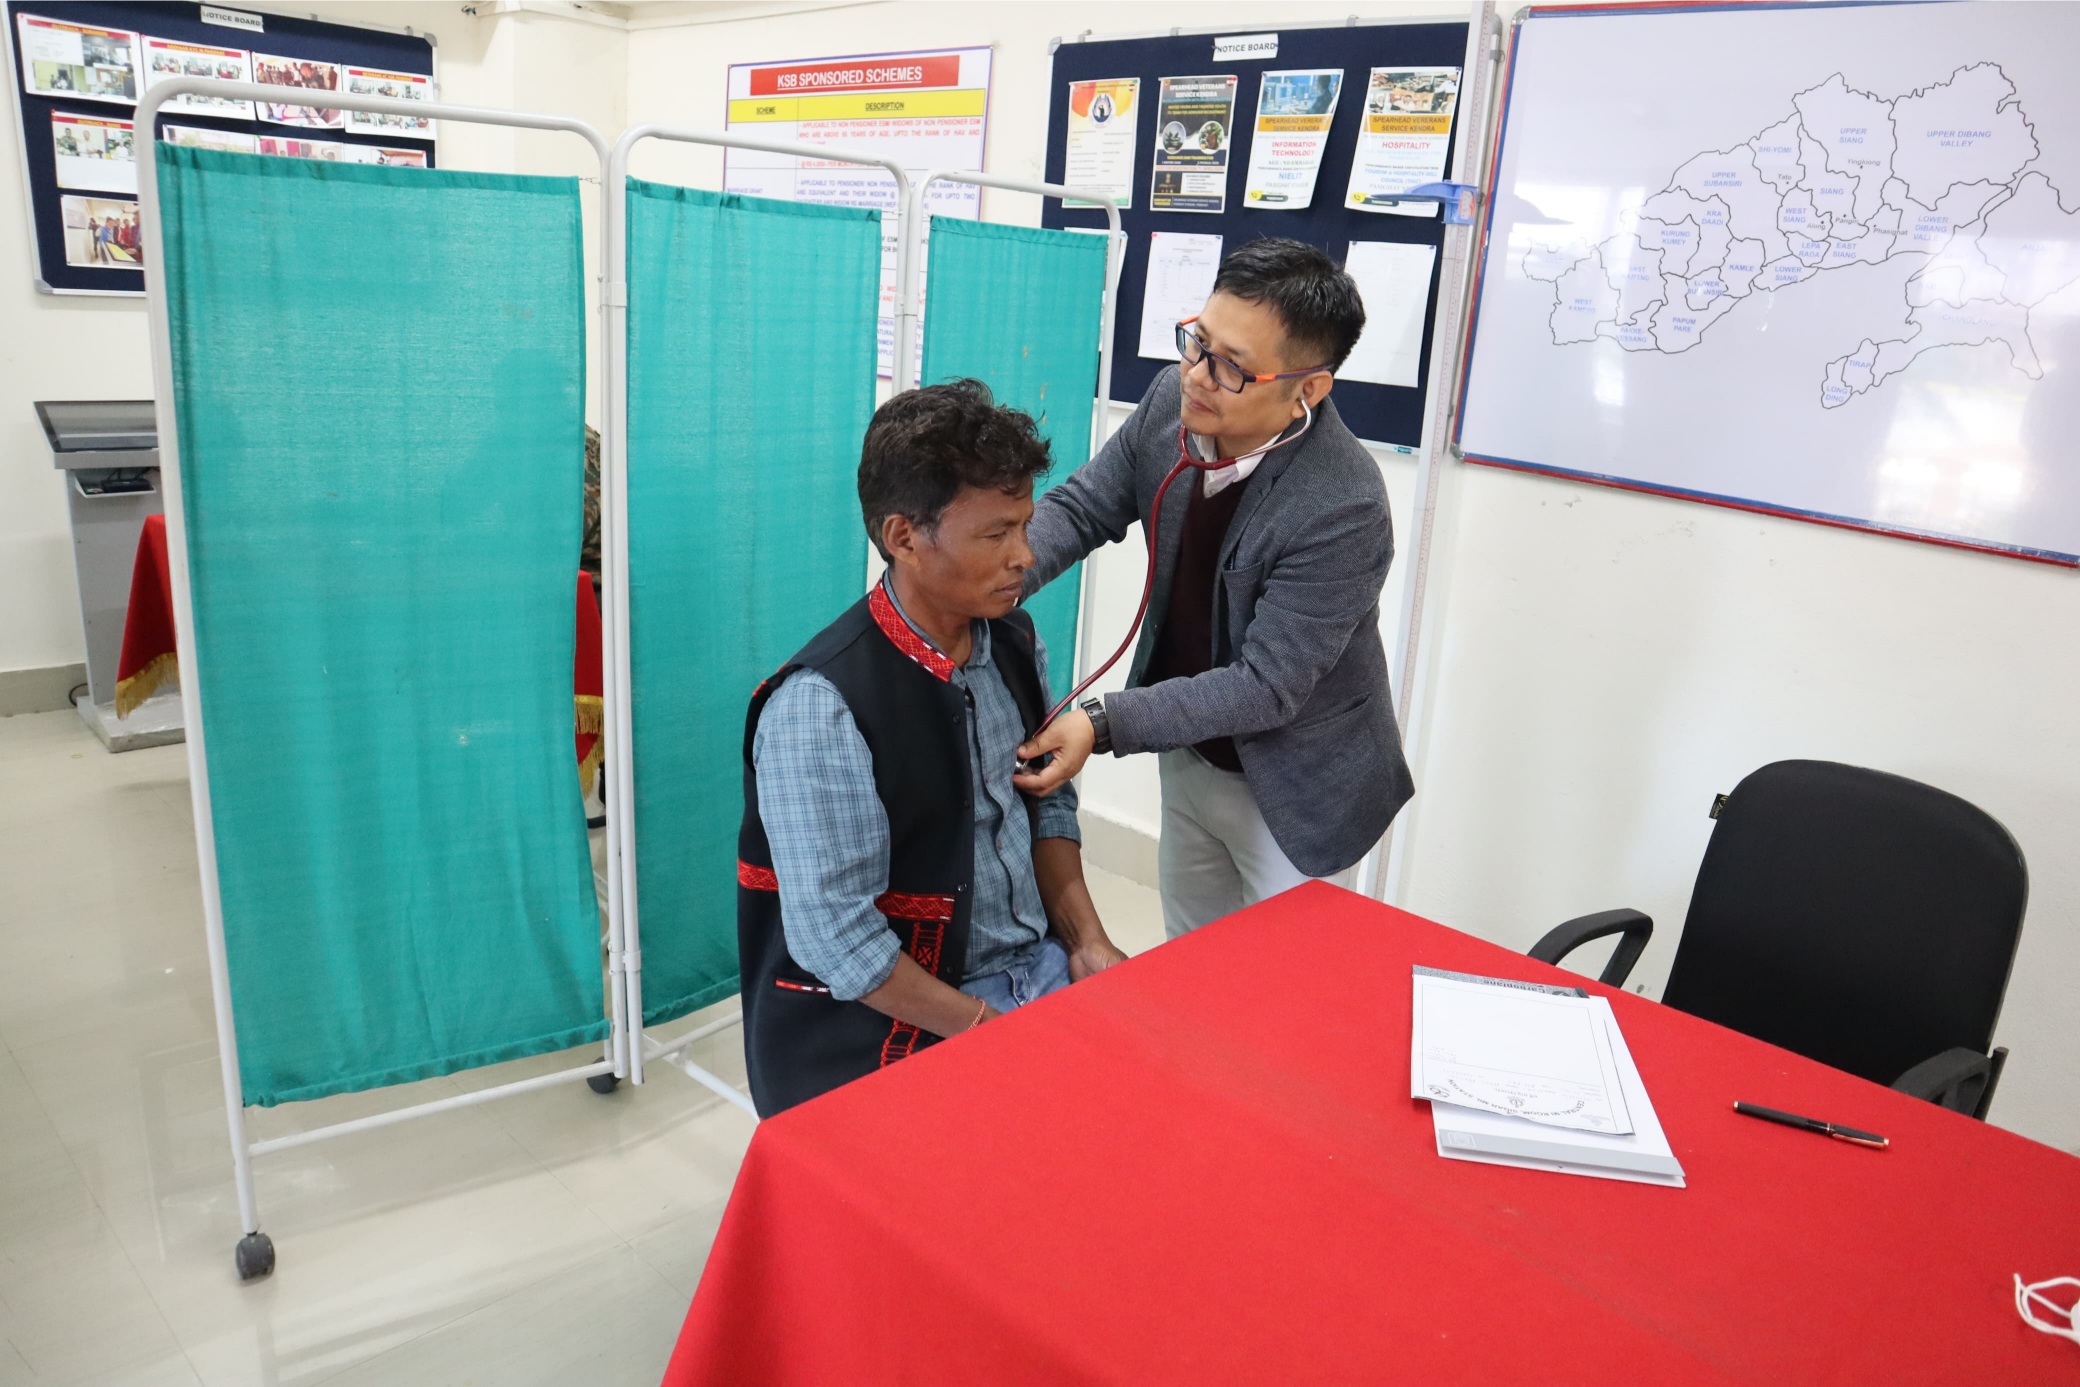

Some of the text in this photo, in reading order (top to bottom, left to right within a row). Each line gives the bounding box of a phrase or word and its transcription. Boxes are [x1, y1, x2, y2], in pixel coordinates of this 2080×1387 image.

[234, 16, 261, 26] BOARD
[1216, 42, 1276, 53] NOTICE BOARD
[777, 65, 923, 88] KSB SPONSORED SCHEMES
[756, 101, 905, 115] SCHEME DESCRIPTION
[1412, 116, 1447, 124] VERERANS
[968, 128, 980, 136] AND
[1840, 127, 1868, 135] UPPER
[1926, 130, 1992, 138] UPPER DIBANG
[1839, 136, 1864, 144] SIANG
[1381, 141, 1431, 150] HOSPITALITY
[1278, 172, 1303, 180] NIELIT
[1778, 173, 1792, 181] Tato
[1820, 187, 1844, 195] SIANG
[945, 192, 960, 200] UPTO
[1701, 218, 1724, 226] DAADI
[1835, 217, 1859, 225] Pangin
[1918, 215, 1949, 224] LOWER
[1806, 222, 1826, 230] Along
[1915, 224, 1947, 233] DIBANG
[1660, 230, 1690, 238] KURUNG
[1662, 238, 1687, 246] KUMEY
[1801, 242, 1821, 250] LEPA
[1836, 242, 1857, 250] EAST
[1798, 250, 1820, 258] RADA
[1832, 251, 1857, 259] SIANG
[1729, 264, 1754, 272] KAMLE
[1775, 274, 1799, 282] SIANG
[1694, 280, 1720, 288] LOWER
[1574, 298, 1593, 306] WEST
[1672, 316, 1697, 325] PAPUM
[1673, 325, 1693, 333] PARE
[1849, 359, 1871, 368] TIRAP
[1826, 385, 1847, 395] LONG
[1825, 393, 1844, 403] DING
[1447, 1078, 1474, 1099] STATION
[1475, 1096, 1489, 1106] MIL
[1559, 1099, 1585, 1116] CENTRAL
